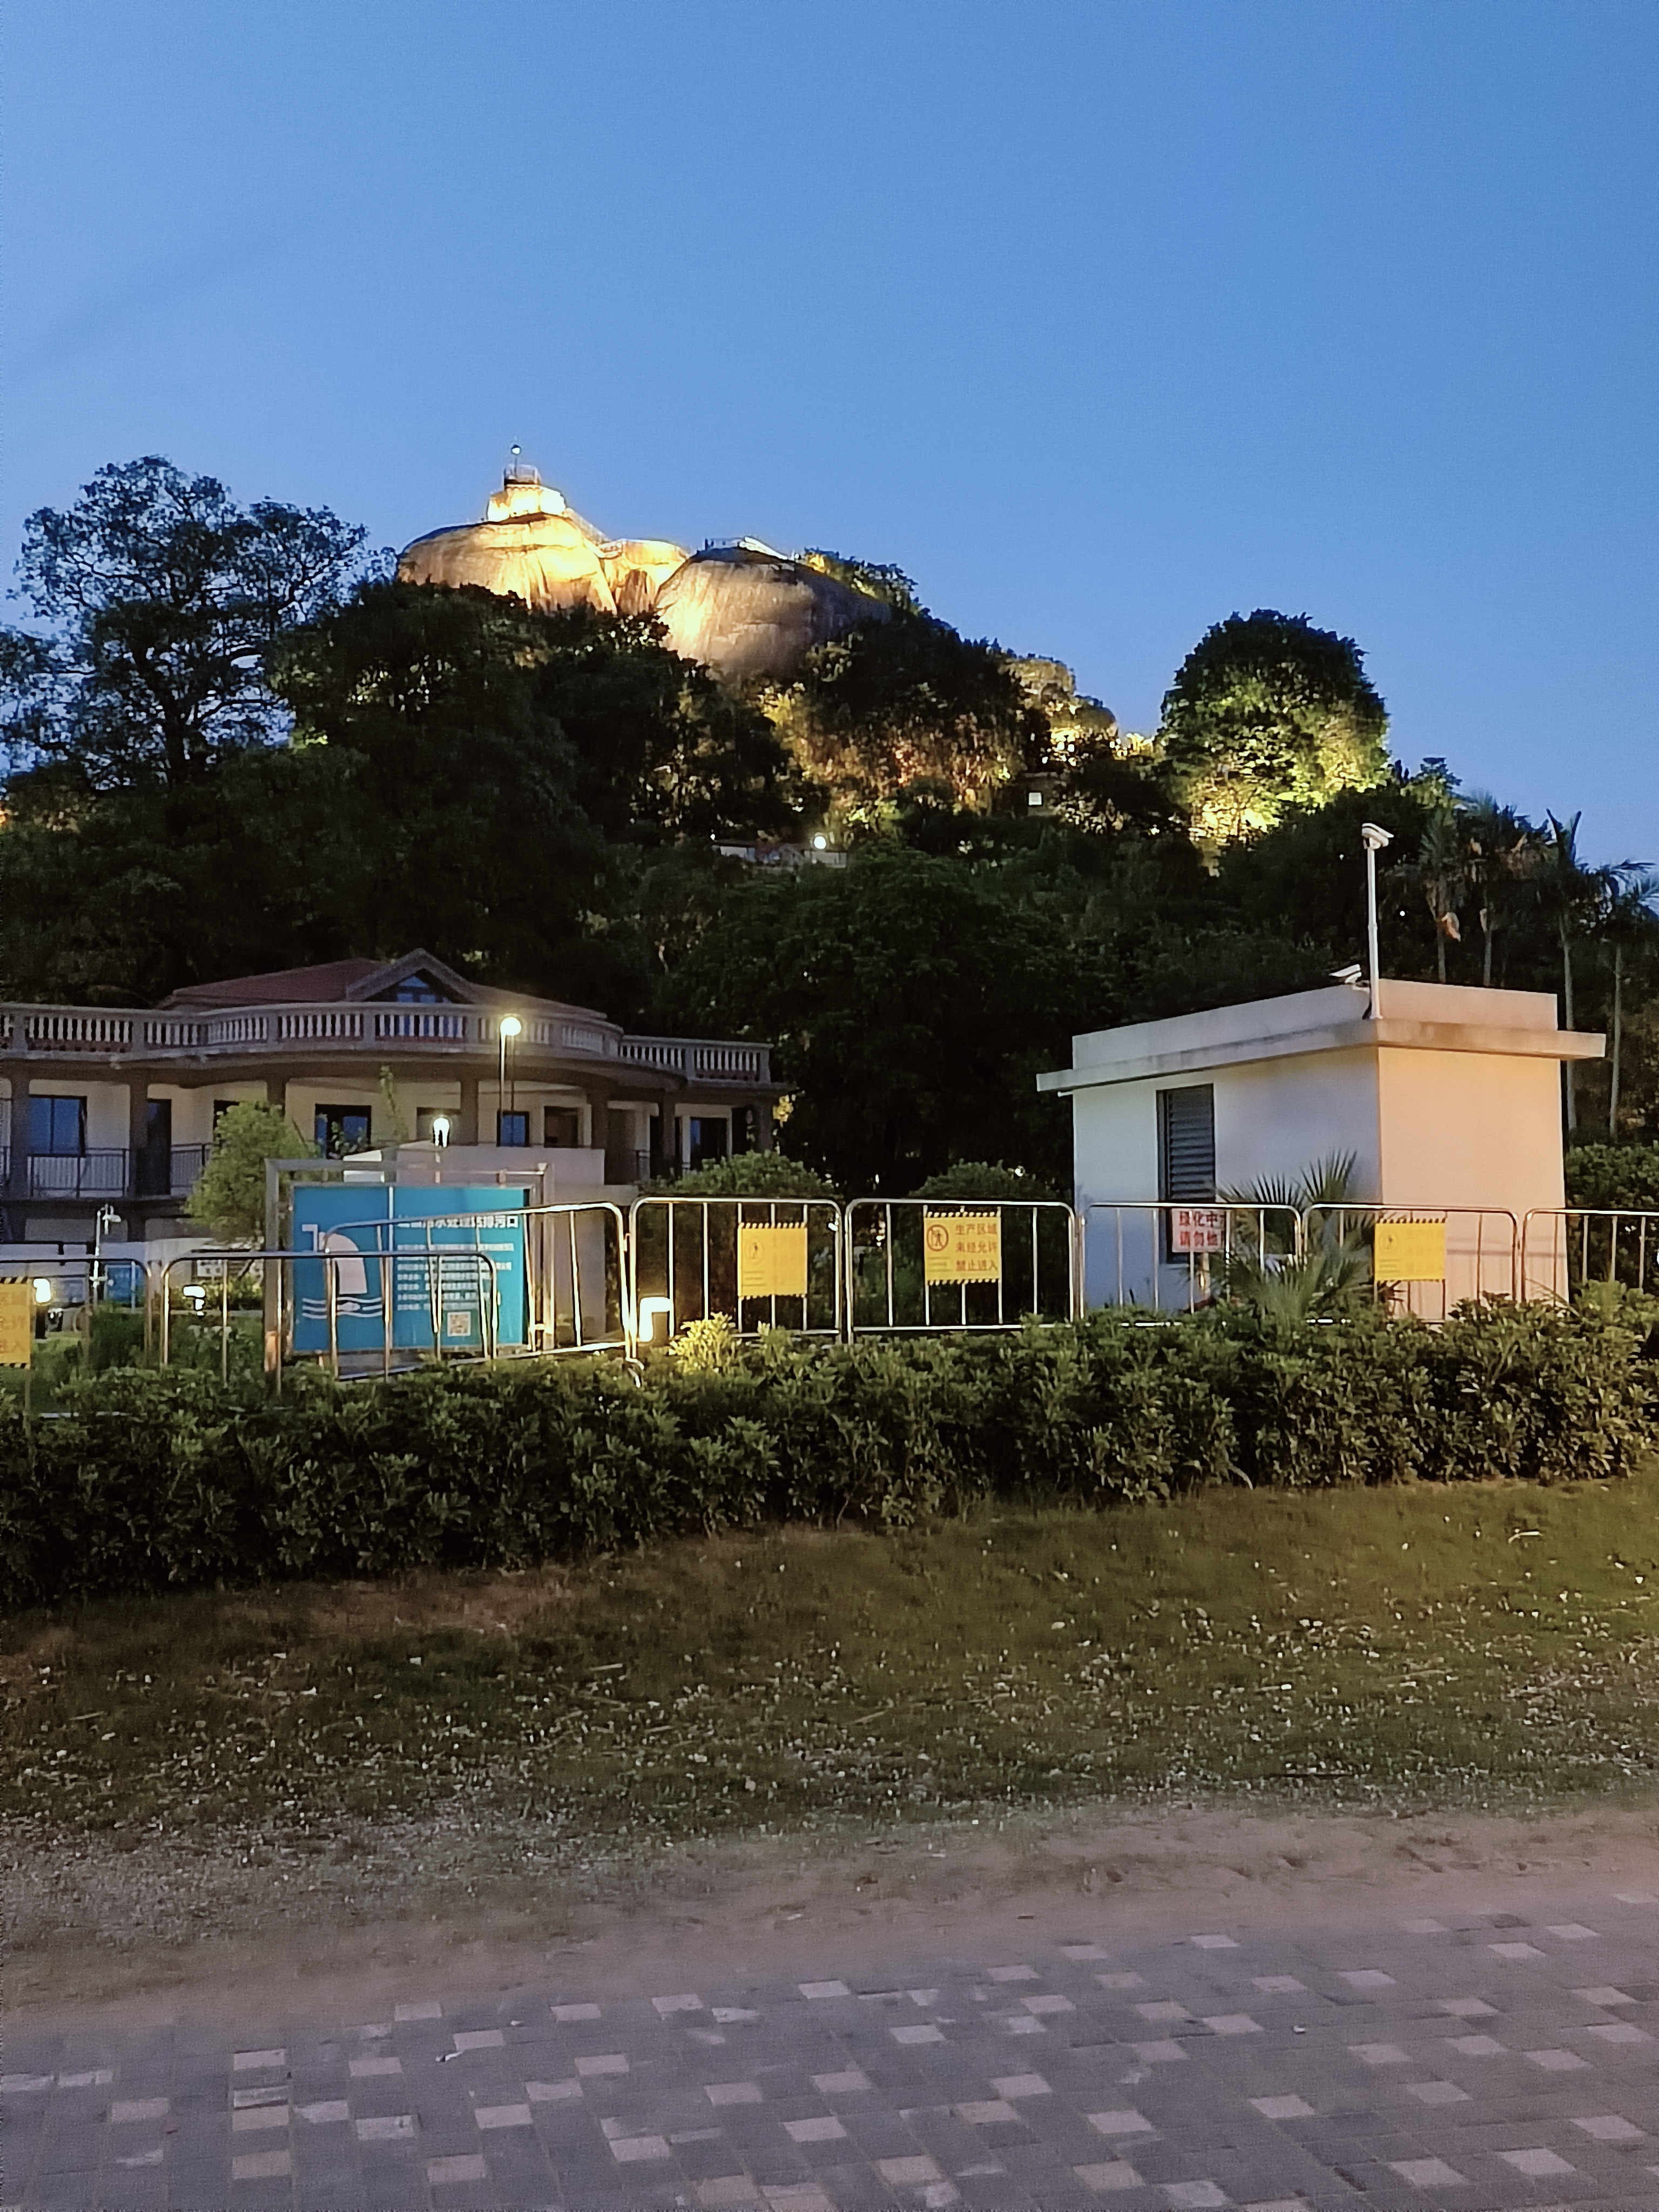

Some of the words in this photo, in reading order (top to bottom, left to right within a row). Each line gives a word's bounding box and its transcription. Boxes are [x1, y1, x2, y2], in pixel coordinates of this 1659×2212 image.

[955, 1223, 997, 1236] 生产区域
[955, 1241, 997, 1253] 未经允许
[956, 1259, 998, 1271] 禁止进入
